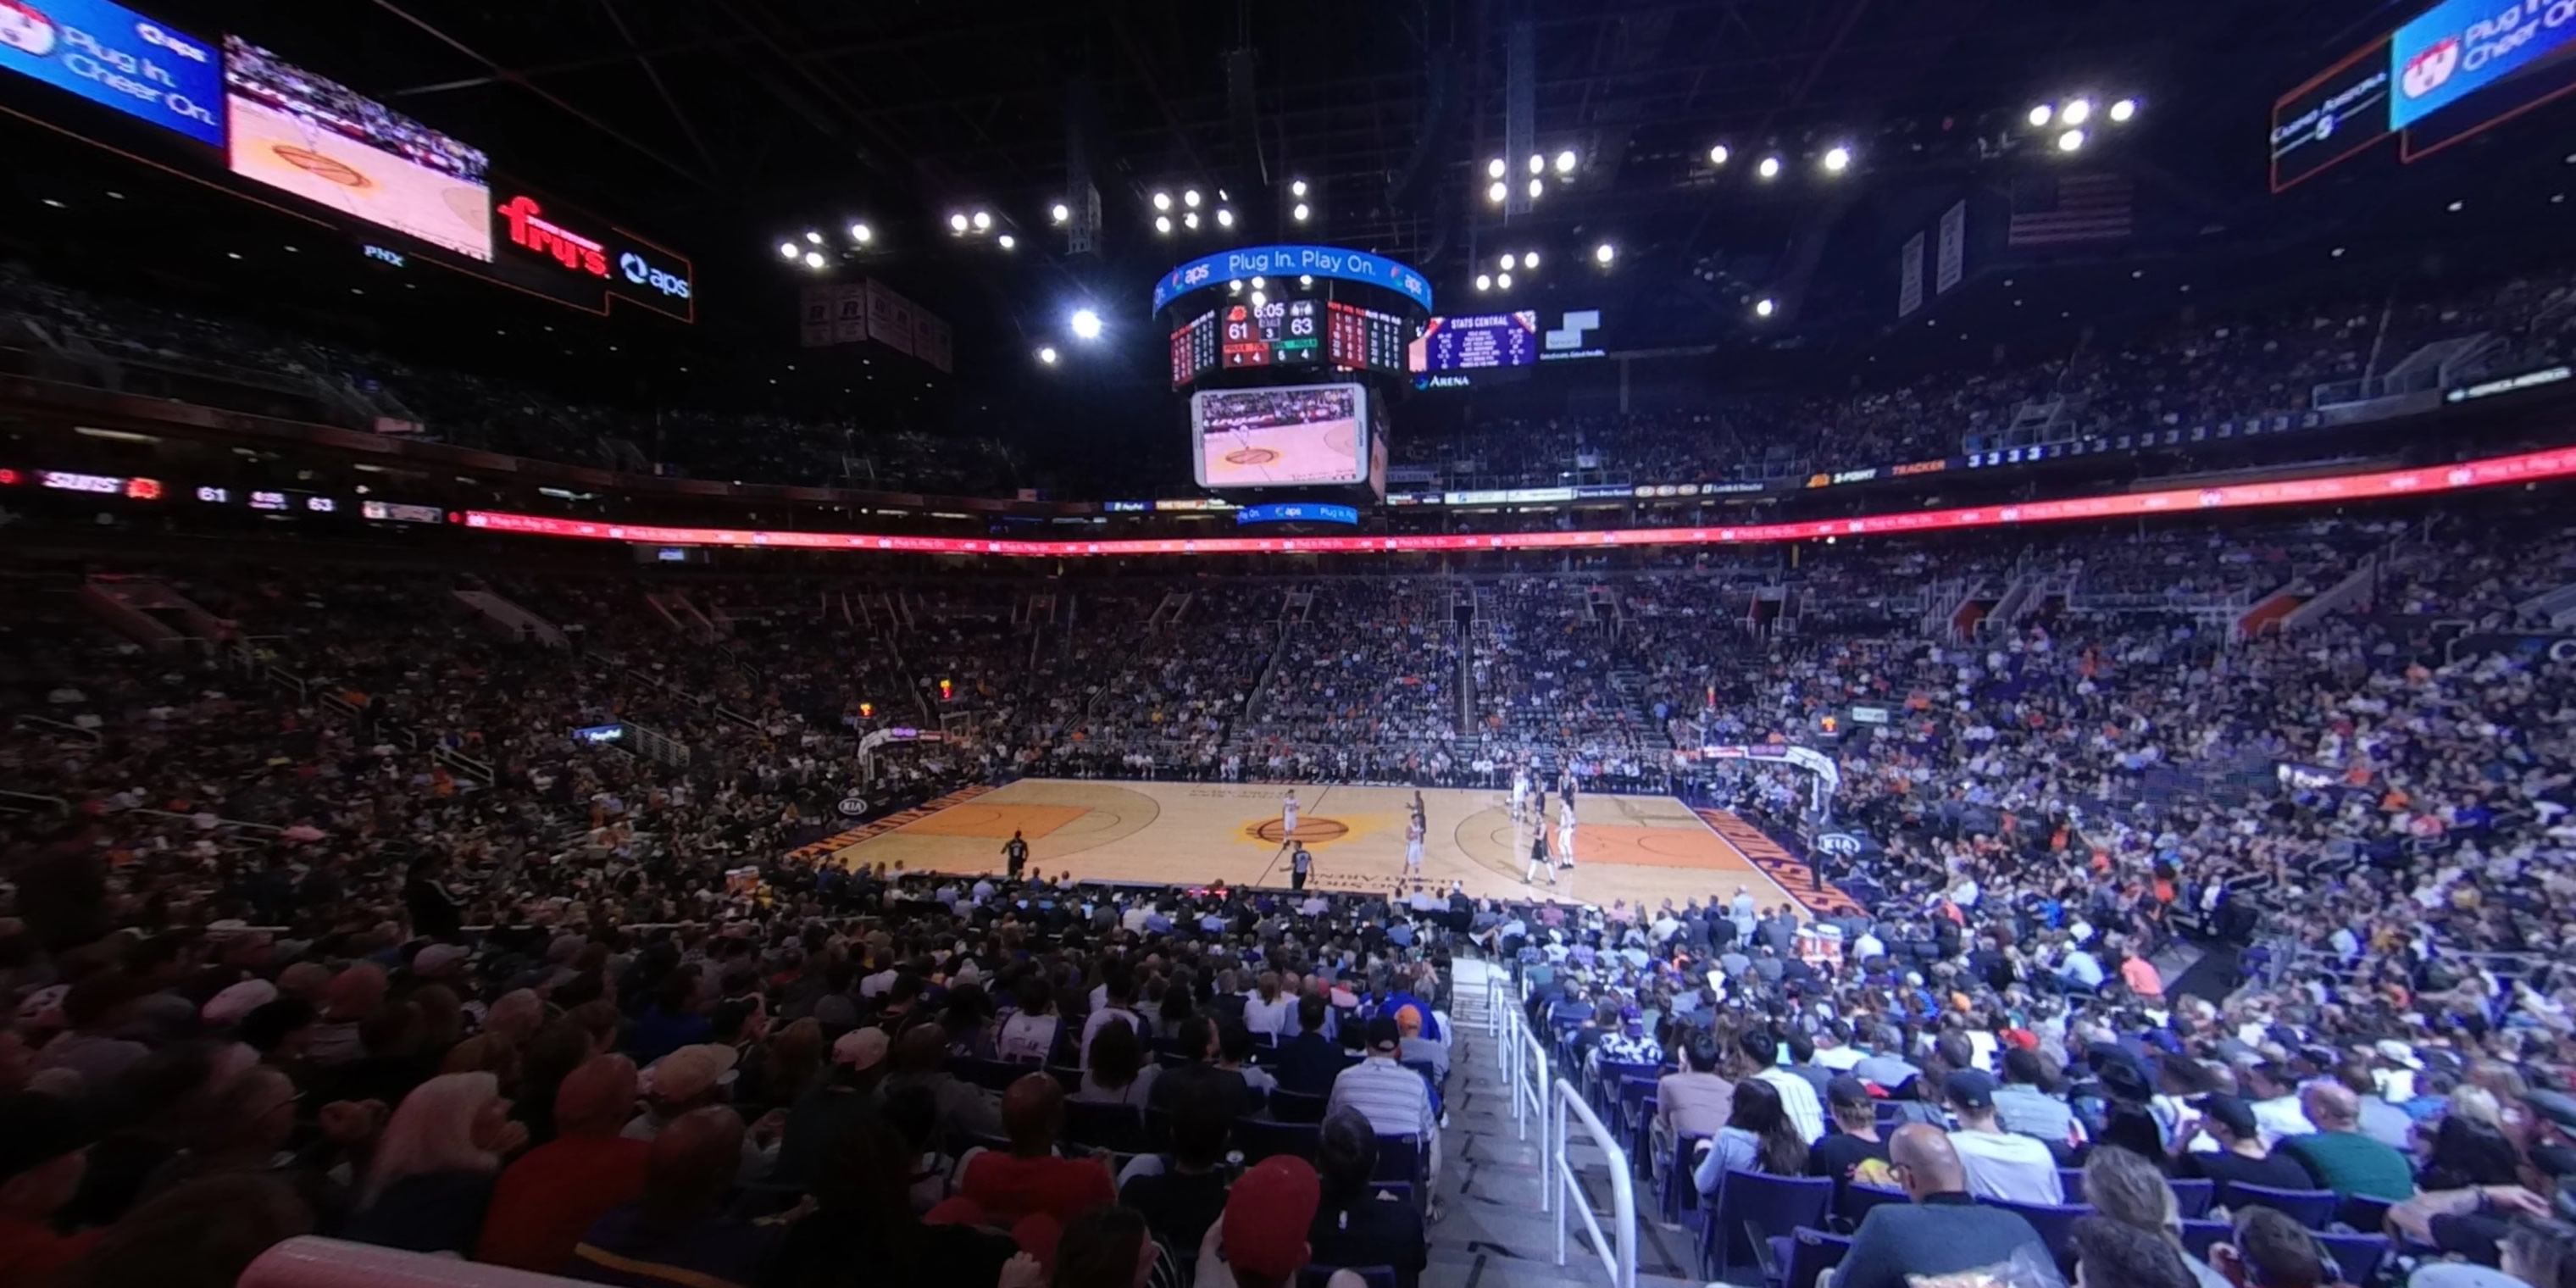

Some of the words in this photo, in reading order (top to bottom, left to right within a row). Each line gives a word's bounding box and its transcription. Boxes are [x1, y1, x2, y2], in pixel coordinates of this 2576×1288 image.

[497, 196, 608, 278] fry's
[364, 244, 405, 268] PHX
[1230, 253, 1269, 272] Plug
[1274, 251, 1295, 268] In.
[1302, 250, 1342, 272] Play
[1347, 256, 1376, 275] On.
[1185, 264, 1211, 285] aps
[649, 268, 690, 298] aps
[1404, 275, 1422, 295] aps
[1253, 303, 1285, 319] 6:05
[1228, 322, 1247, 339] 61
[1291, 318, 1313, 335] 63
[1451, 317, 1473, 330] STATS
[1474, 315, 1509, 328] CENTRAL
[1265, 328, 1274, 338] 3
[1234, 353, 1241, 364] 4
[1252, 351, 1261, 362] 4
[1301, 348, 1309, 359] 4
[1430, 375, 1469, 387] ARENA
[1968, 453, 1981, 468] 3
[1987, 452, 2000, 465] 3
[2007, 448, 2021, 463] 3
[2027, 446, 2040, 460] 3
[1892, 459, 1946, 475] TRACKER
[197, 486, 228, 502] 61
[308, 497, 336, 511] 63
[1285, 507, 1302, 517] aps
[1320, 507, 1337, 519] Plug
[843, 802, 863, 812] KIA
[1824, 835, 1855, 852] KIA
